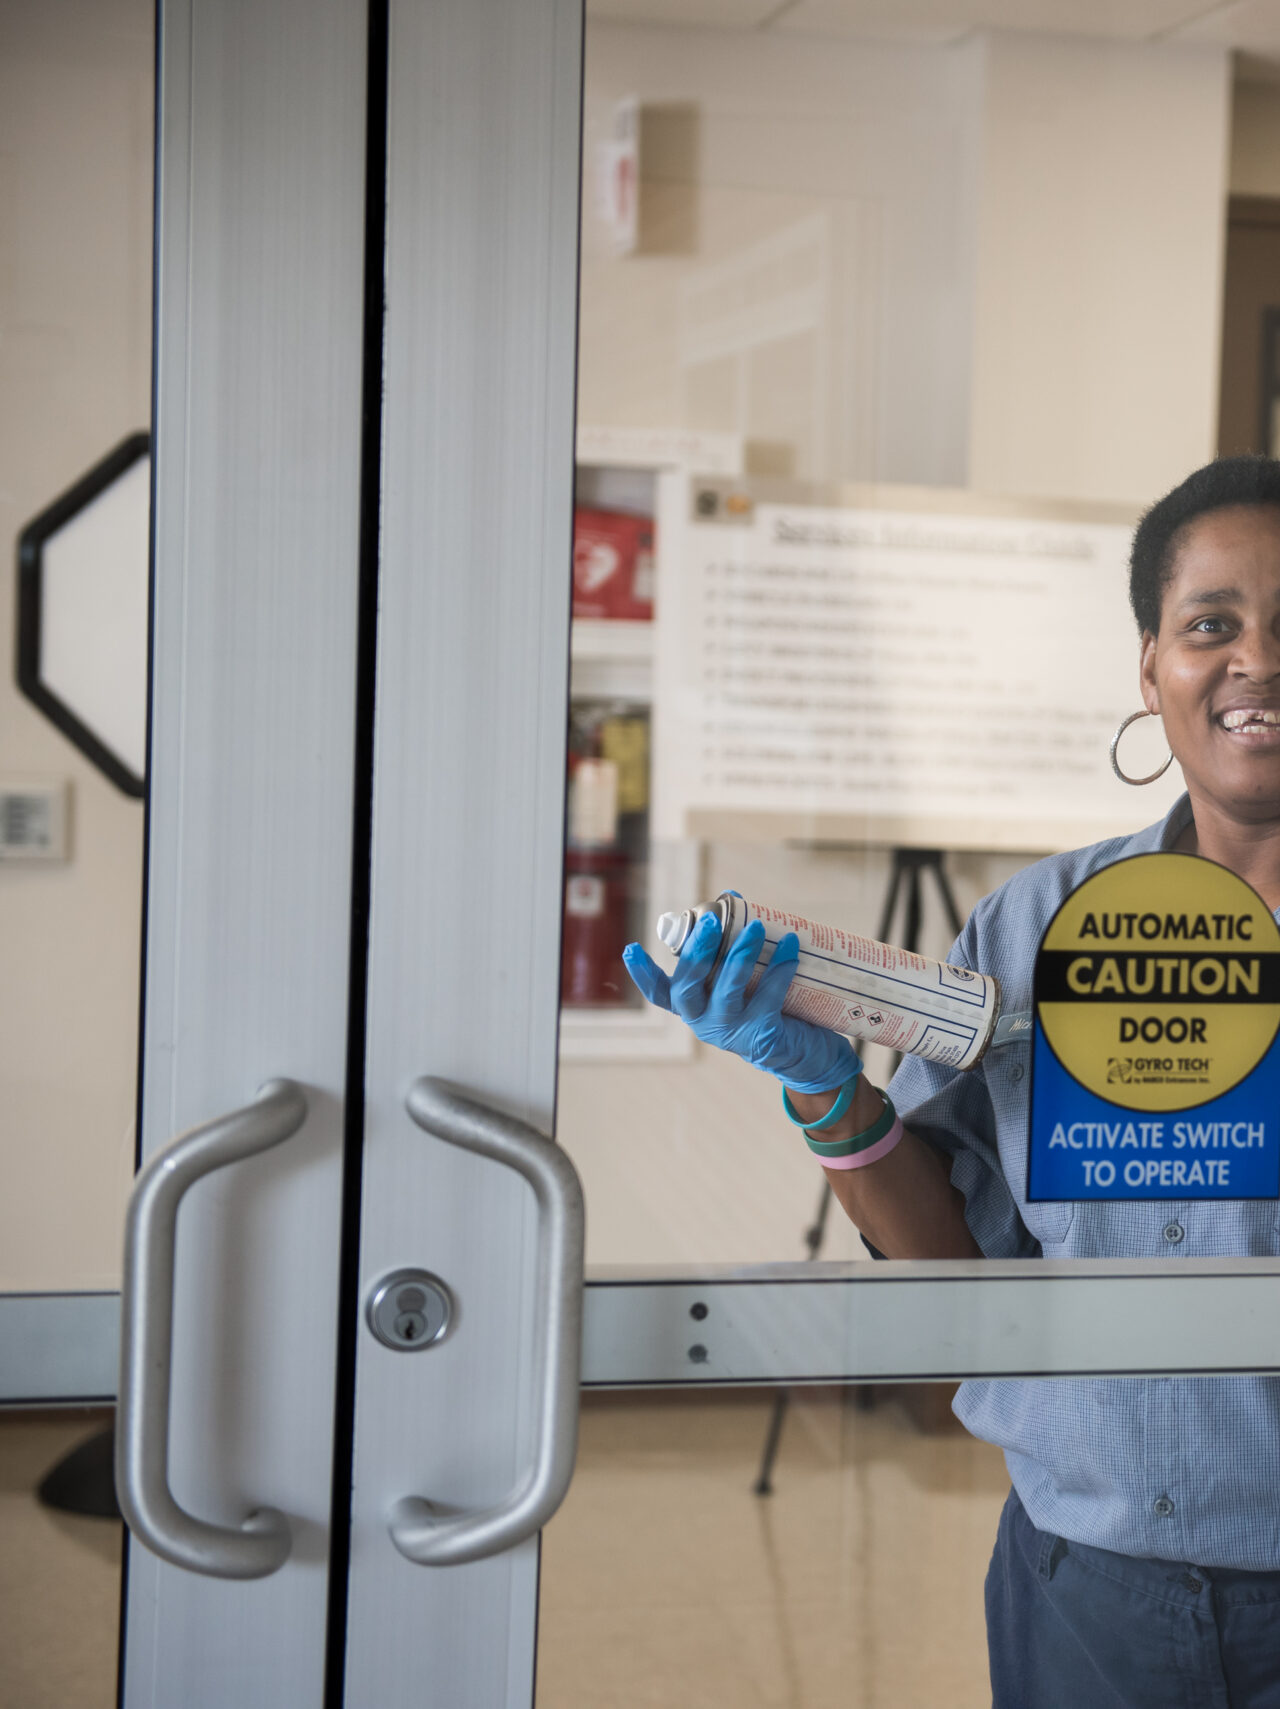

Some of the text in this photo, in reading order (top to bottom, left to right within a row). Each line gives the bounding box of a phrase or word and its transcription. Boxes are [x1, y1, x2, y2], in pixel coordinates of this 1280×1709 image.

[1078, 913, 1253, 940] AUTOMATIC
[1066, 957, 1260, 995] CAUTION
[1119, 1017, 1207, 1043] DOOR
[1135, 1058, 1209, 1071] GYRO TECH
[1049, 1122, 1264, 1149] ACTIVATE SWITCH
[1083, 1160, 1230, 1187] TO OPERATE
